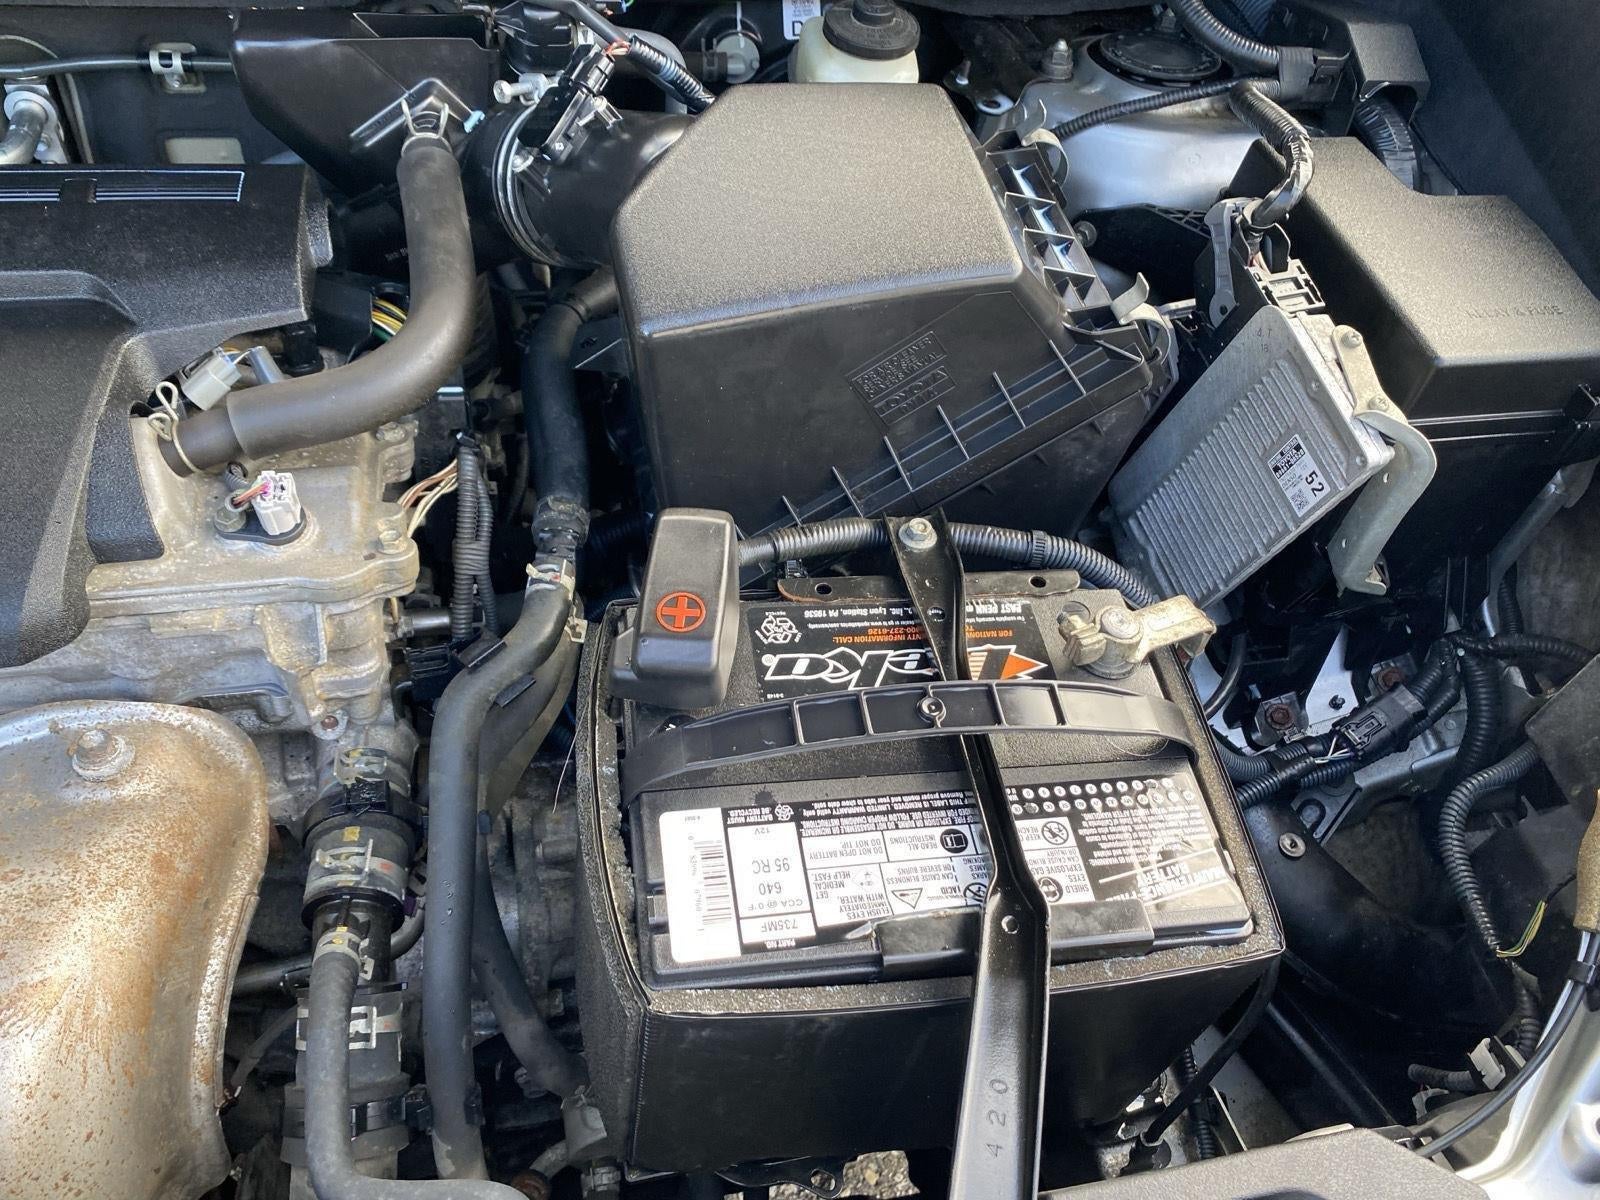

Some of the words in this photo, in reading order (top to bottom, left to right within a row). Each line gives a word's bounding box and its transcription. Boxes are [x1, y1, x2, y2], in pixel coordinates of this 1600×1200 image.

[877, 365, 947, 416] TOYOTA
[1277, 447, 1296, 469] TOYOTA
[1305, 470, 1324, 497] 52
[828, 609, 839, 618] PA
[840, 608, 868, 618] Station,
[869, 606, 886, 616] Lyon
[975, 604, 998, 614] PENN
[804, 610, 826, 618] 19536
[998, 628, 1012, 637] FOR
[832, 636, 852, 644] CALL:
[854, 634, 905, 643] INFORMATION
[920, 792, 940, 800] proper
[940, 791, 964, 800] Remove
[890, 800, 922, 810] REMOVED.
[930, 799, 948, 808] LABEL
[948, 798, 963, 806] THIS
[832, 805, 866, 815] WARRANTY
[866, 804, 890, 812] LIMITED
[726, 816, 745, 824] MUST
[746, 814, 773, 823] BATTERY
[856, 839, 868, 847] NOT
[871, 838, 880, 846] DO
[890, 834, 936, 844] INSTRUCTIONS
[874, 846, 883, 854] DO
[907, 843, 919, 851] ALL
[920, 842, 938, 850] READ
[809, 850, 837, 860] BATTERY
[840, 848, 856, 857] OPEN
[859, 848, 872, 856] NOT
[1068, 848, 1076, 856] OR
[1028, 858, 1046, 866] BLIND
[1047, 856, 1065, 864] CAUSE
[1067, 855, 1080, 863] CAN
[752, 859, 770, 874] RC
[774, 858, 790, 872] 95
[920, 864, 940, 872] SEVERE
[1046, 864, 1082, 874] EXPLOSIVE
[896, 866, 918, 874] BURNS
[1030, 866, 1044, 876] GAS
[833, 870, 850, 880] HELP
[920, 872, 940, 882] CAUSE
[941, 872, 954, 880] CAN
[886, 875, 919, 885] BLINDNESS
[758, 882, 782, 896] 640
[812, 880, 844, 890] MEDICAL
[1065, 884, 1090, 894] SHIELD
[940, 886, 956, 894] ACID
[815, 890, 828, 900] GET
[866, 892, 884, 902] WITH
[780, 898, 803, 907] CCA
[839, 900, 886, 912] IMMEDIATELY
[846, 910, 865, 920] EYES
[866, 906, 889, 917] FLUSH
[761, 918, 798, 932] 735MF
[764, 940, 777, 948] NO.
[778, 938, 796, 948] PART
